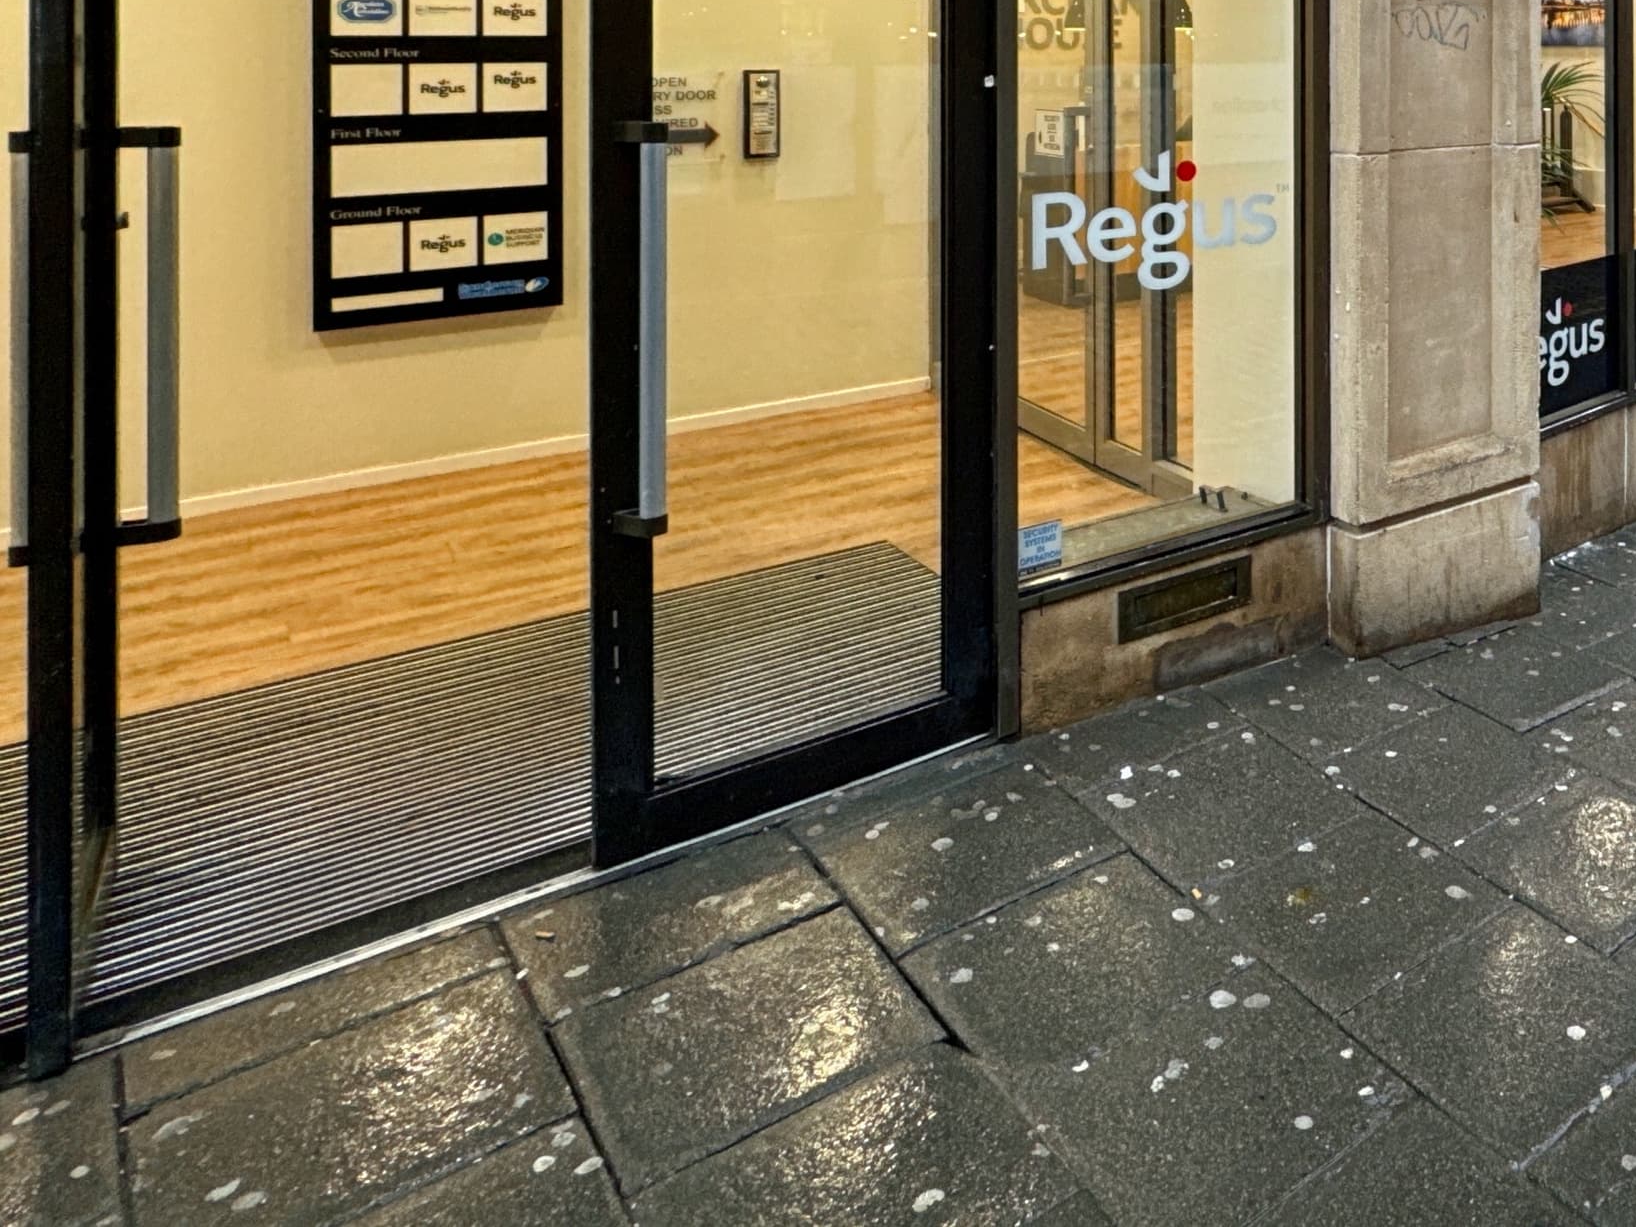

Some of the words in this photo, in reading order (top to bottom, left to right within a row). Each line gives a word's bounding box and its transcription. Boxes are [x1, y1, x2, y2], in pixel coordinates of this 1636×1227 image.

[493, 6, 537, 21] Regus
[329, 47, 380, 58] Second
[384, 47, 420, 58] Floor
[494, 74, 537, 89] Regus
[420, 83, 466, 98] Regus
[675, 90, 717, 101] DOOR
[330, 129, 361, 139] First
[365, 127, 401, 138] Floor
[329, 207, 382, 220] Ground
[386, 205, 422, 217] Floor
[420, 237, 466, 253] Regus
[1031, 190, 1278, 291] Regus
